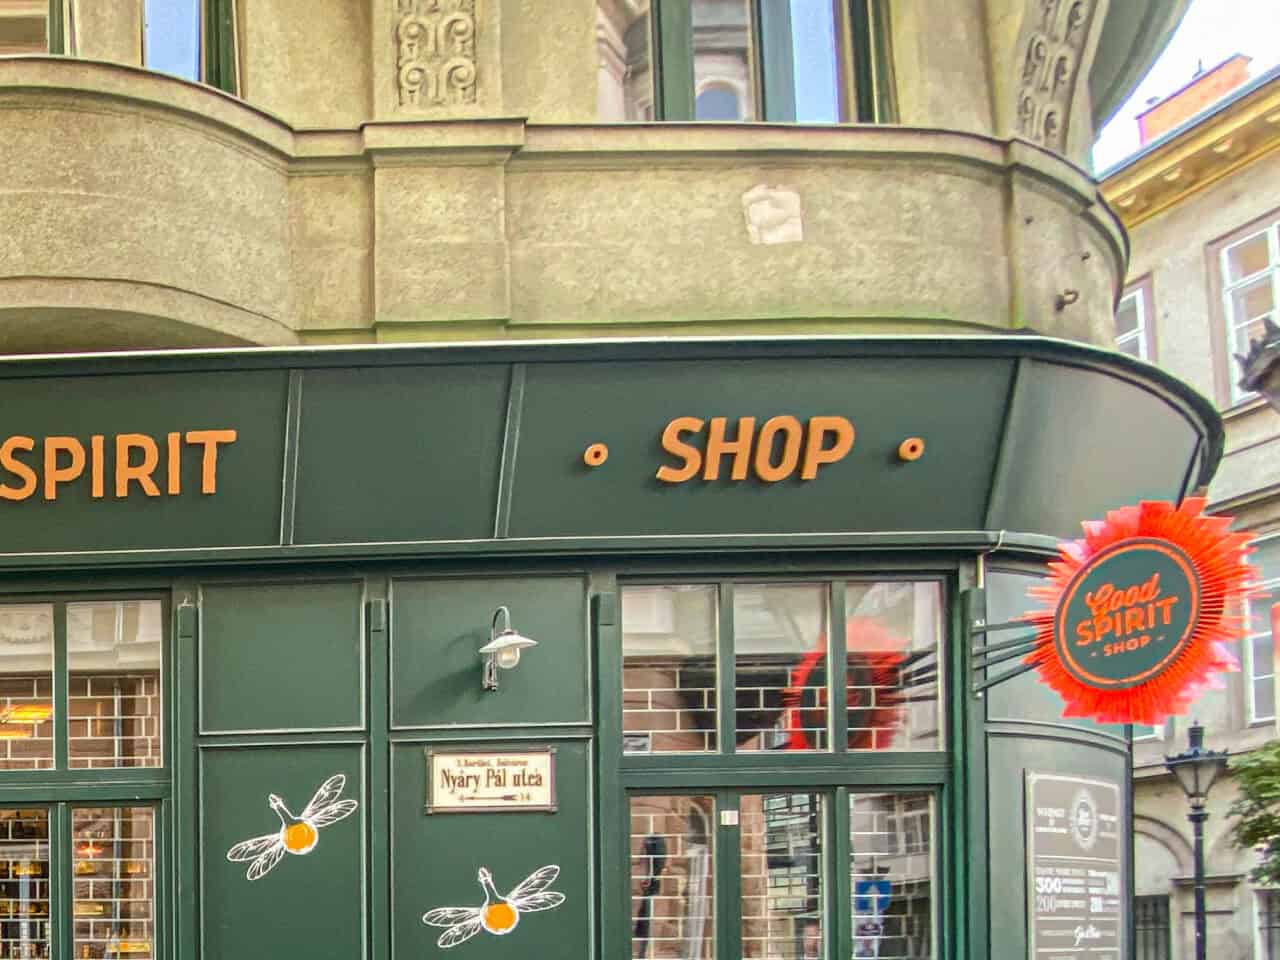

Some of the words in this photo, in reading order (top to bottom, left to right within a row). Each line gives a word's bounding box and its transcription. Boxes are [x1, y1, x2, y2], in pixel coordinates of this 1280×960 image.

[655, 415, 856, 483] SHOP
[1085, 572, 1162, 617] Good
[1075, 596, 1179, 647] SPIRIT
[1103, 636, 1152, 657] SHOP
[440, 768, 481, 793] Nyáry
[485, 768, 506, 788] Pál
[513, 768, 543, 787] utca
